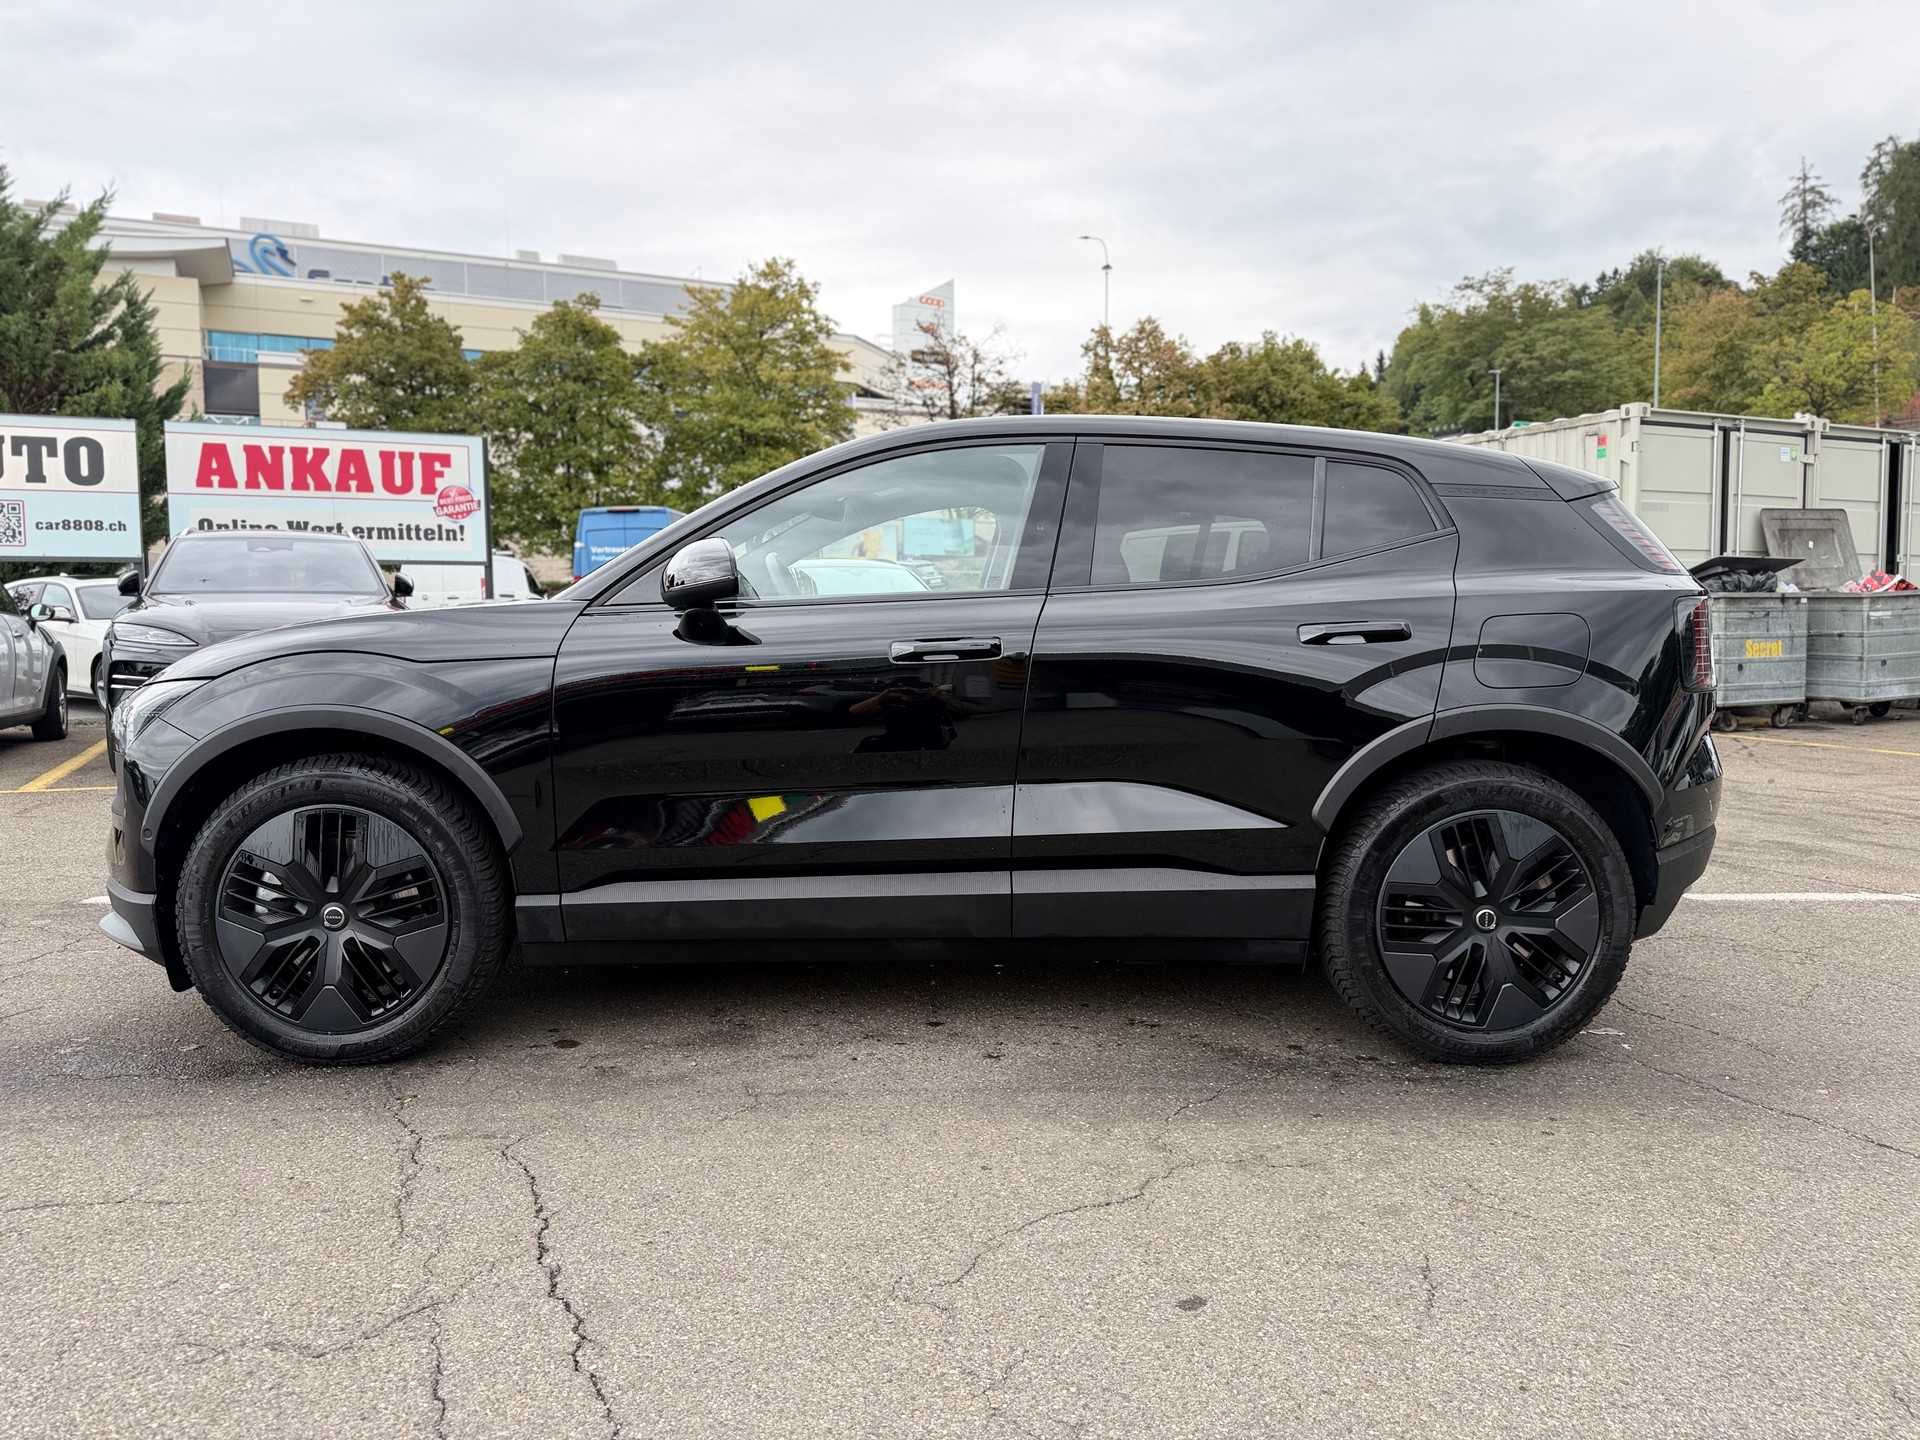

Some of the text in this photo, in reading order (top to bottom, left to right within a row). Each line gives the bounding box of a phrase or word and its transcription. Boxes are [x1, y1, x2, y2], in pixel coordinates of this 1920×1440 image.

[0, 435, 105, 486] TO
[196, 442, 452, 495] ANKAUF
[436, 501, 480, 515] GARANTIE
[35, 519, 127, 532] car8808.ch
[352, 523, 465, 542] ermitteln!
[1745, 639, 1783, 657] Secret
